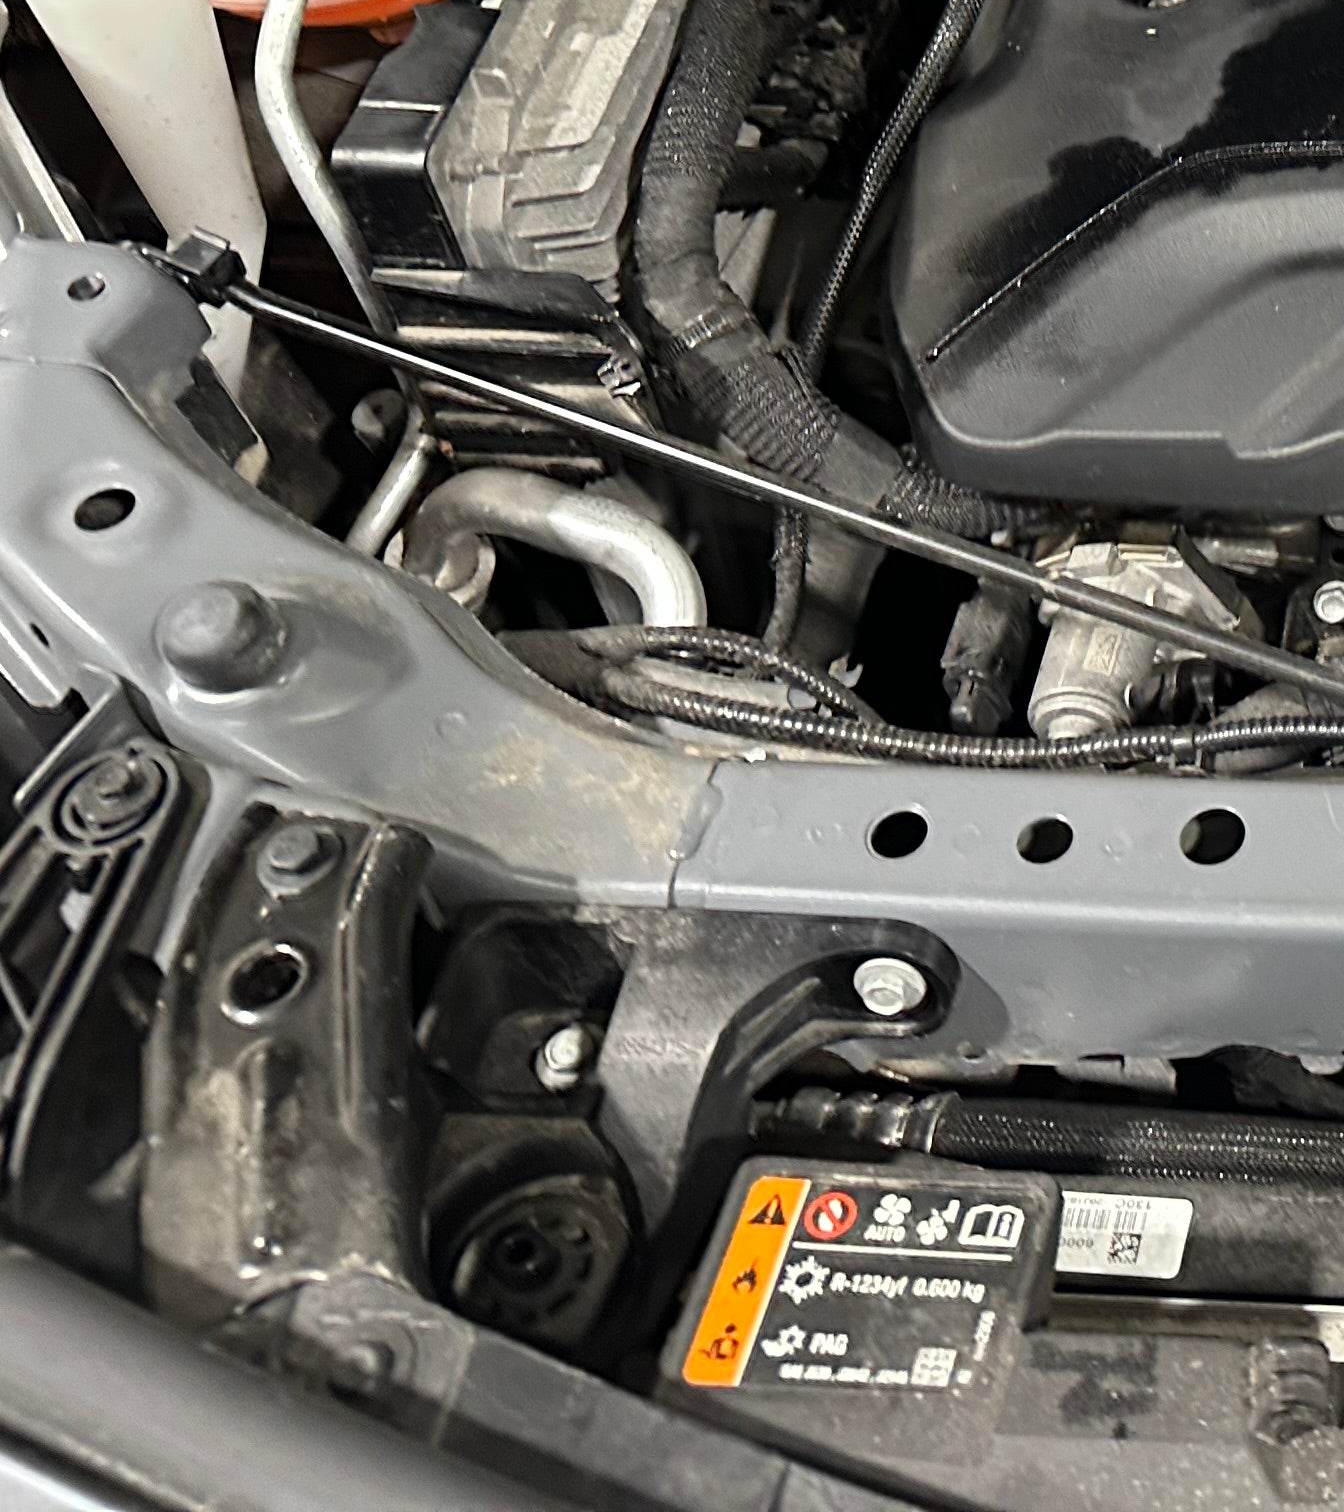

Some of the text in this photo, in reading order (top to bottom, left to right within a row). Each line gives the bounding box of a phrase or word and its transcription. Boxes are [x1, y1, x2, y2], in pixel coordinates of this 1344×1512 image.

[864, 1224, 906, 1242] AUTO
[829, 1272, 909, 1298] R-1234yf
[808, 1332, 849, 1356] PAG
